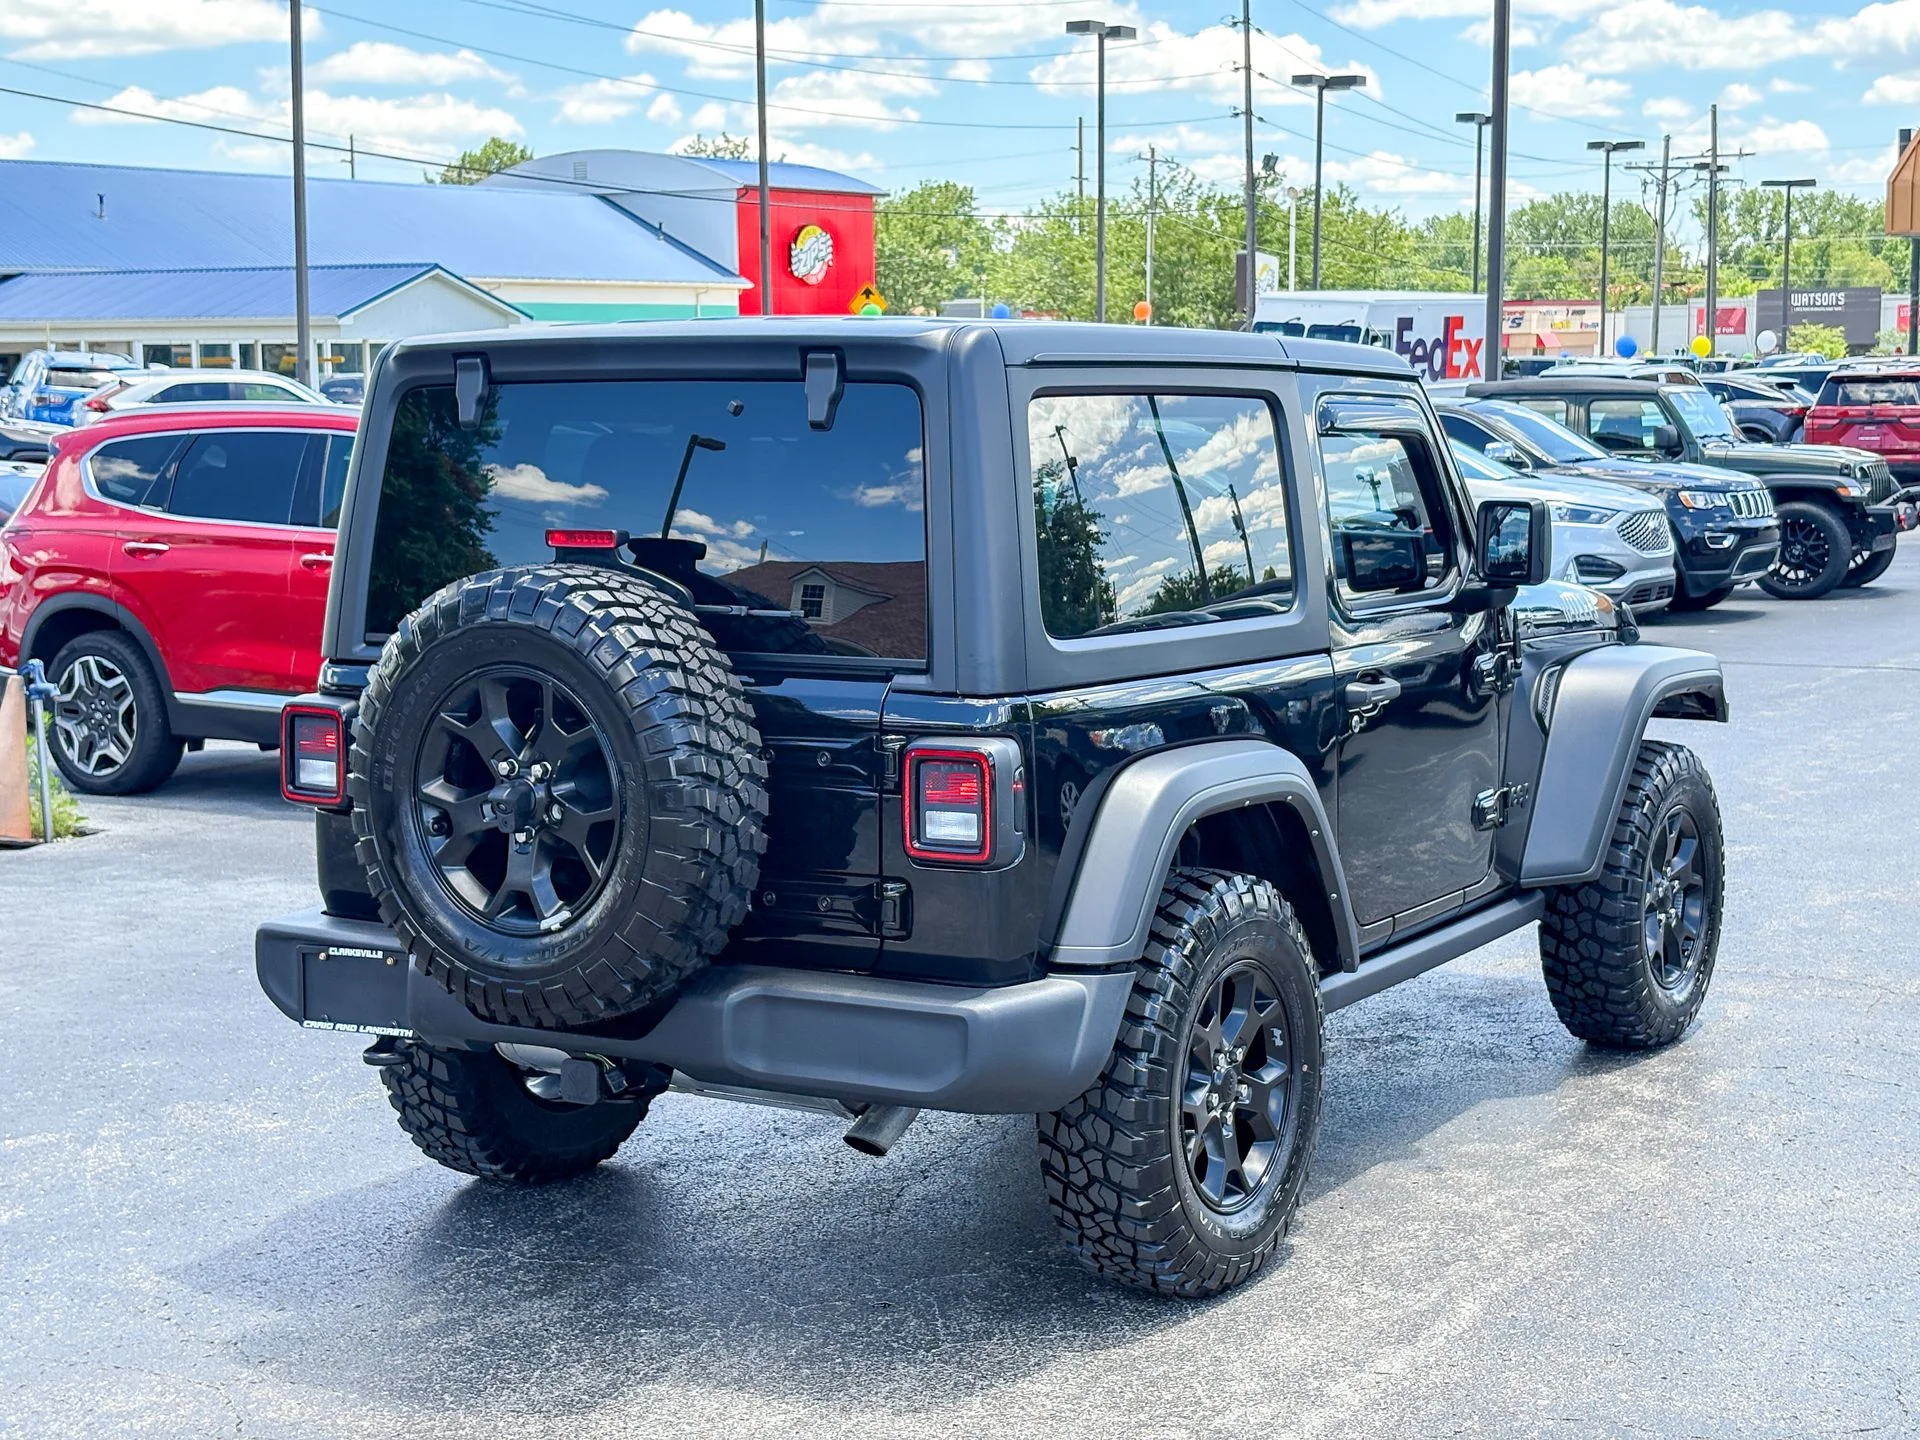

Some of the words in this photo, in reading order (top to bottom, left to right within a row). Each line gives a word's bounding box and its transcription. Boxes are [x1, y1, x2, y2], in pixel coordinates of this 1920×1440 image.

[1791, 292, 1845, 306] WATSON'S
[1396, 315, 1484, 382] FedEx
[328, 946, 384, 959] CLARKSVILLE
[335, 1022, 358, 1032] AND
